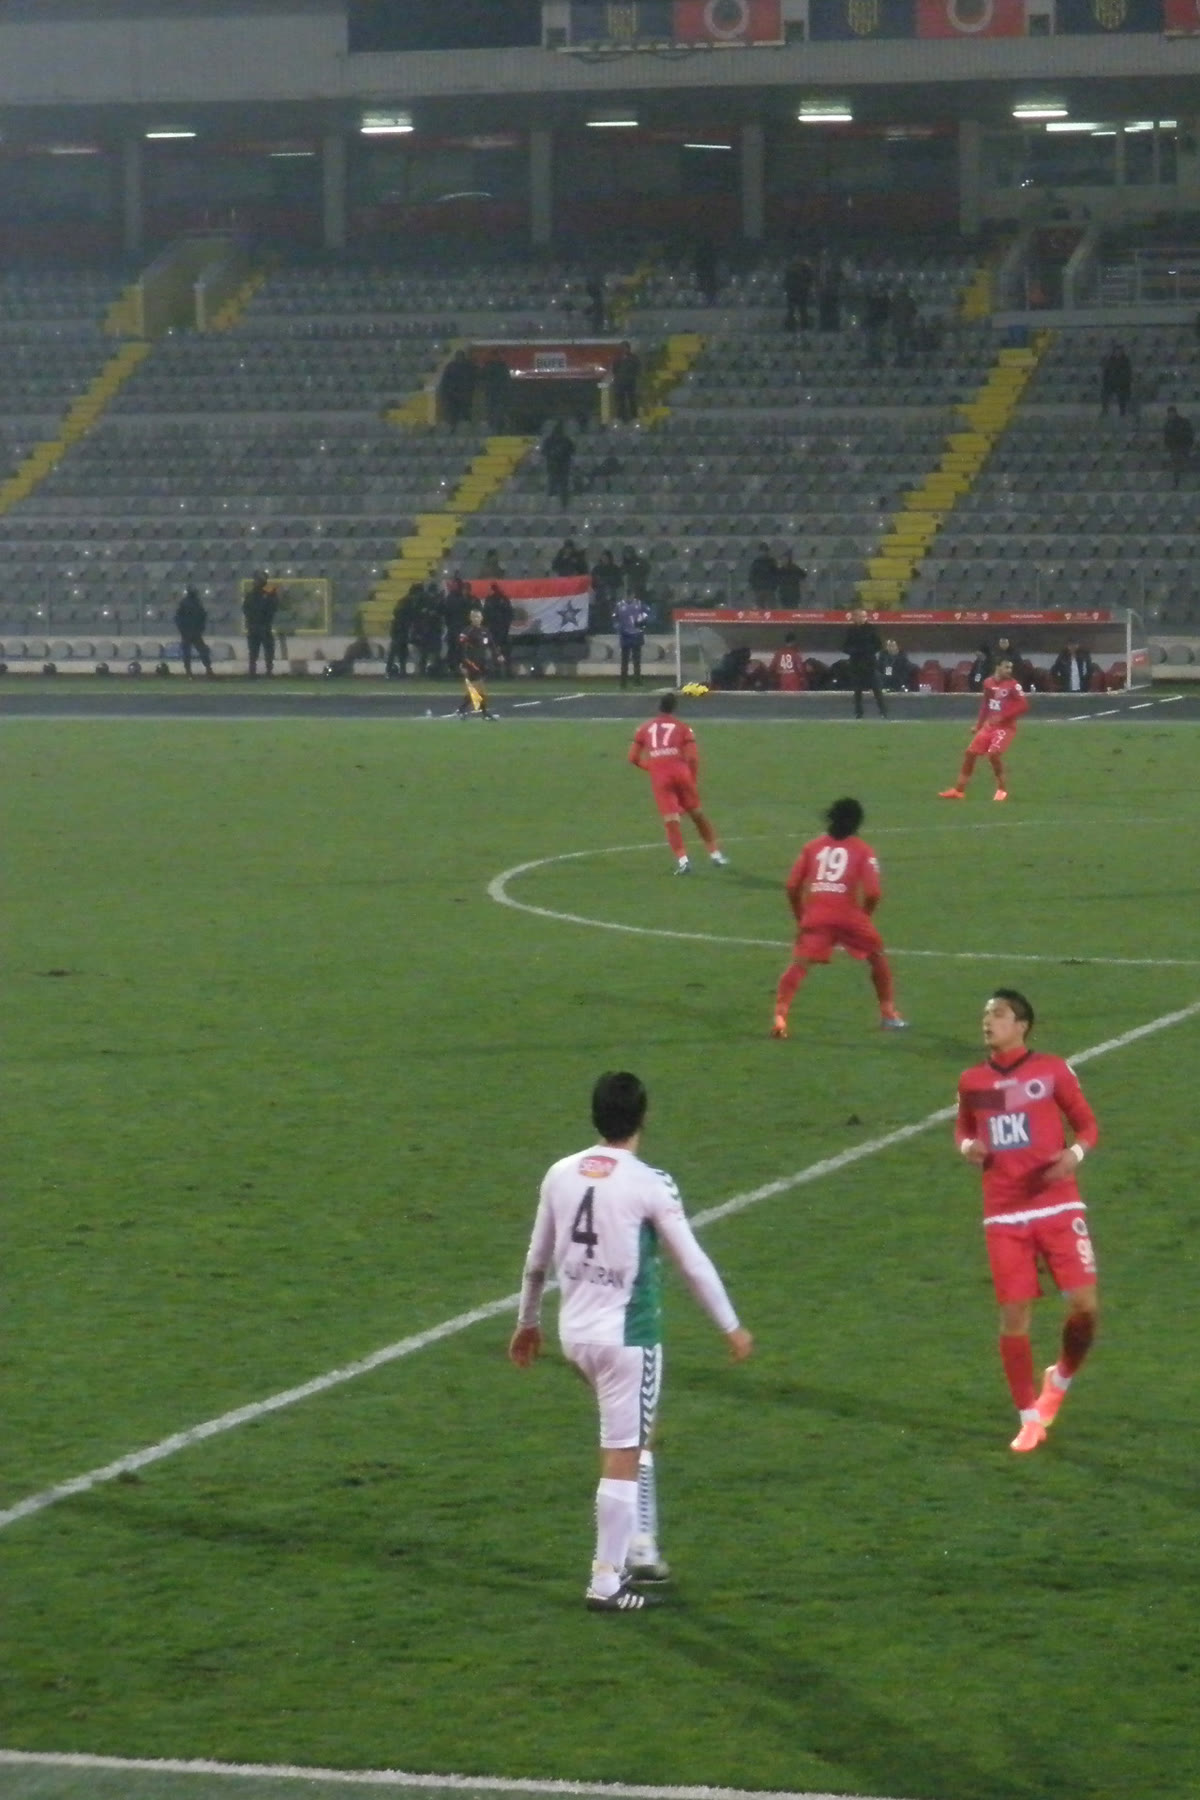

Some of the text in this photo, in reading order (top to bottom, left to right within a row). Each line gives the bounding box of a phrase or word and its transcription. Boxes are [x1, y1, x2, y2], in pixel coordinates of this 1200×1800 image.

[780, 653, 793, 670] 48
[647, 722, 677, 748] 17
[815, 845, 849, 882] 19
[570, 1185, 599, 1259] 4
